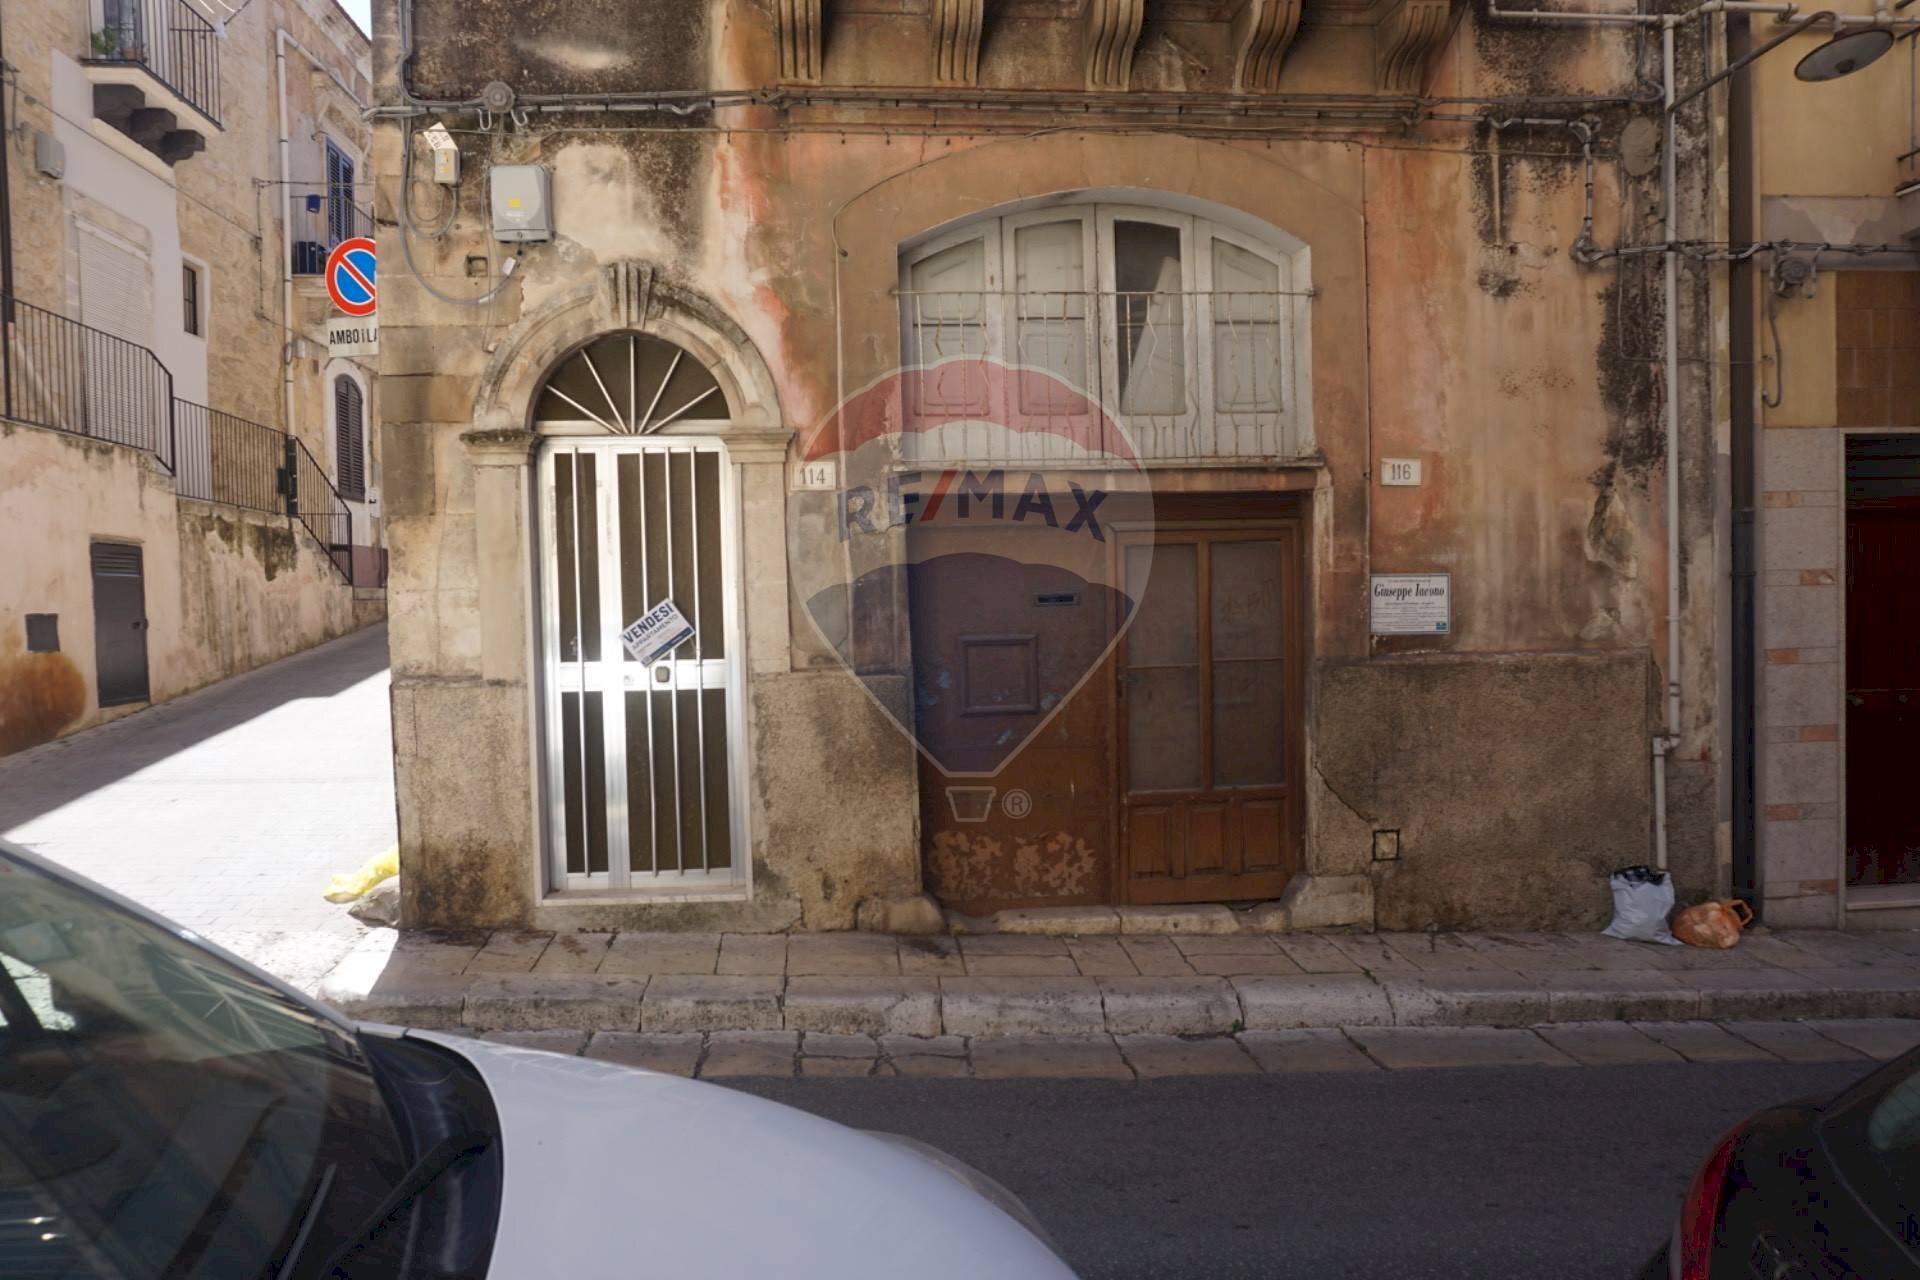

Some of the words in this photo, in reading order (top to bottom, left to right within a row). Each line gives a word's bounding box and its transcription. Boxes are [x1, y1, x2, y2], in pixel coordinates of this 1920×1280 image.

[800, 467, 826, 485] 114
[1392, 463, 1411, 480] 116
[1374, 583, 1412, 601] Giuseppe
[1415, 583, 1445, 597] Iacono
[623, 602, 675, 643] VENDESI
